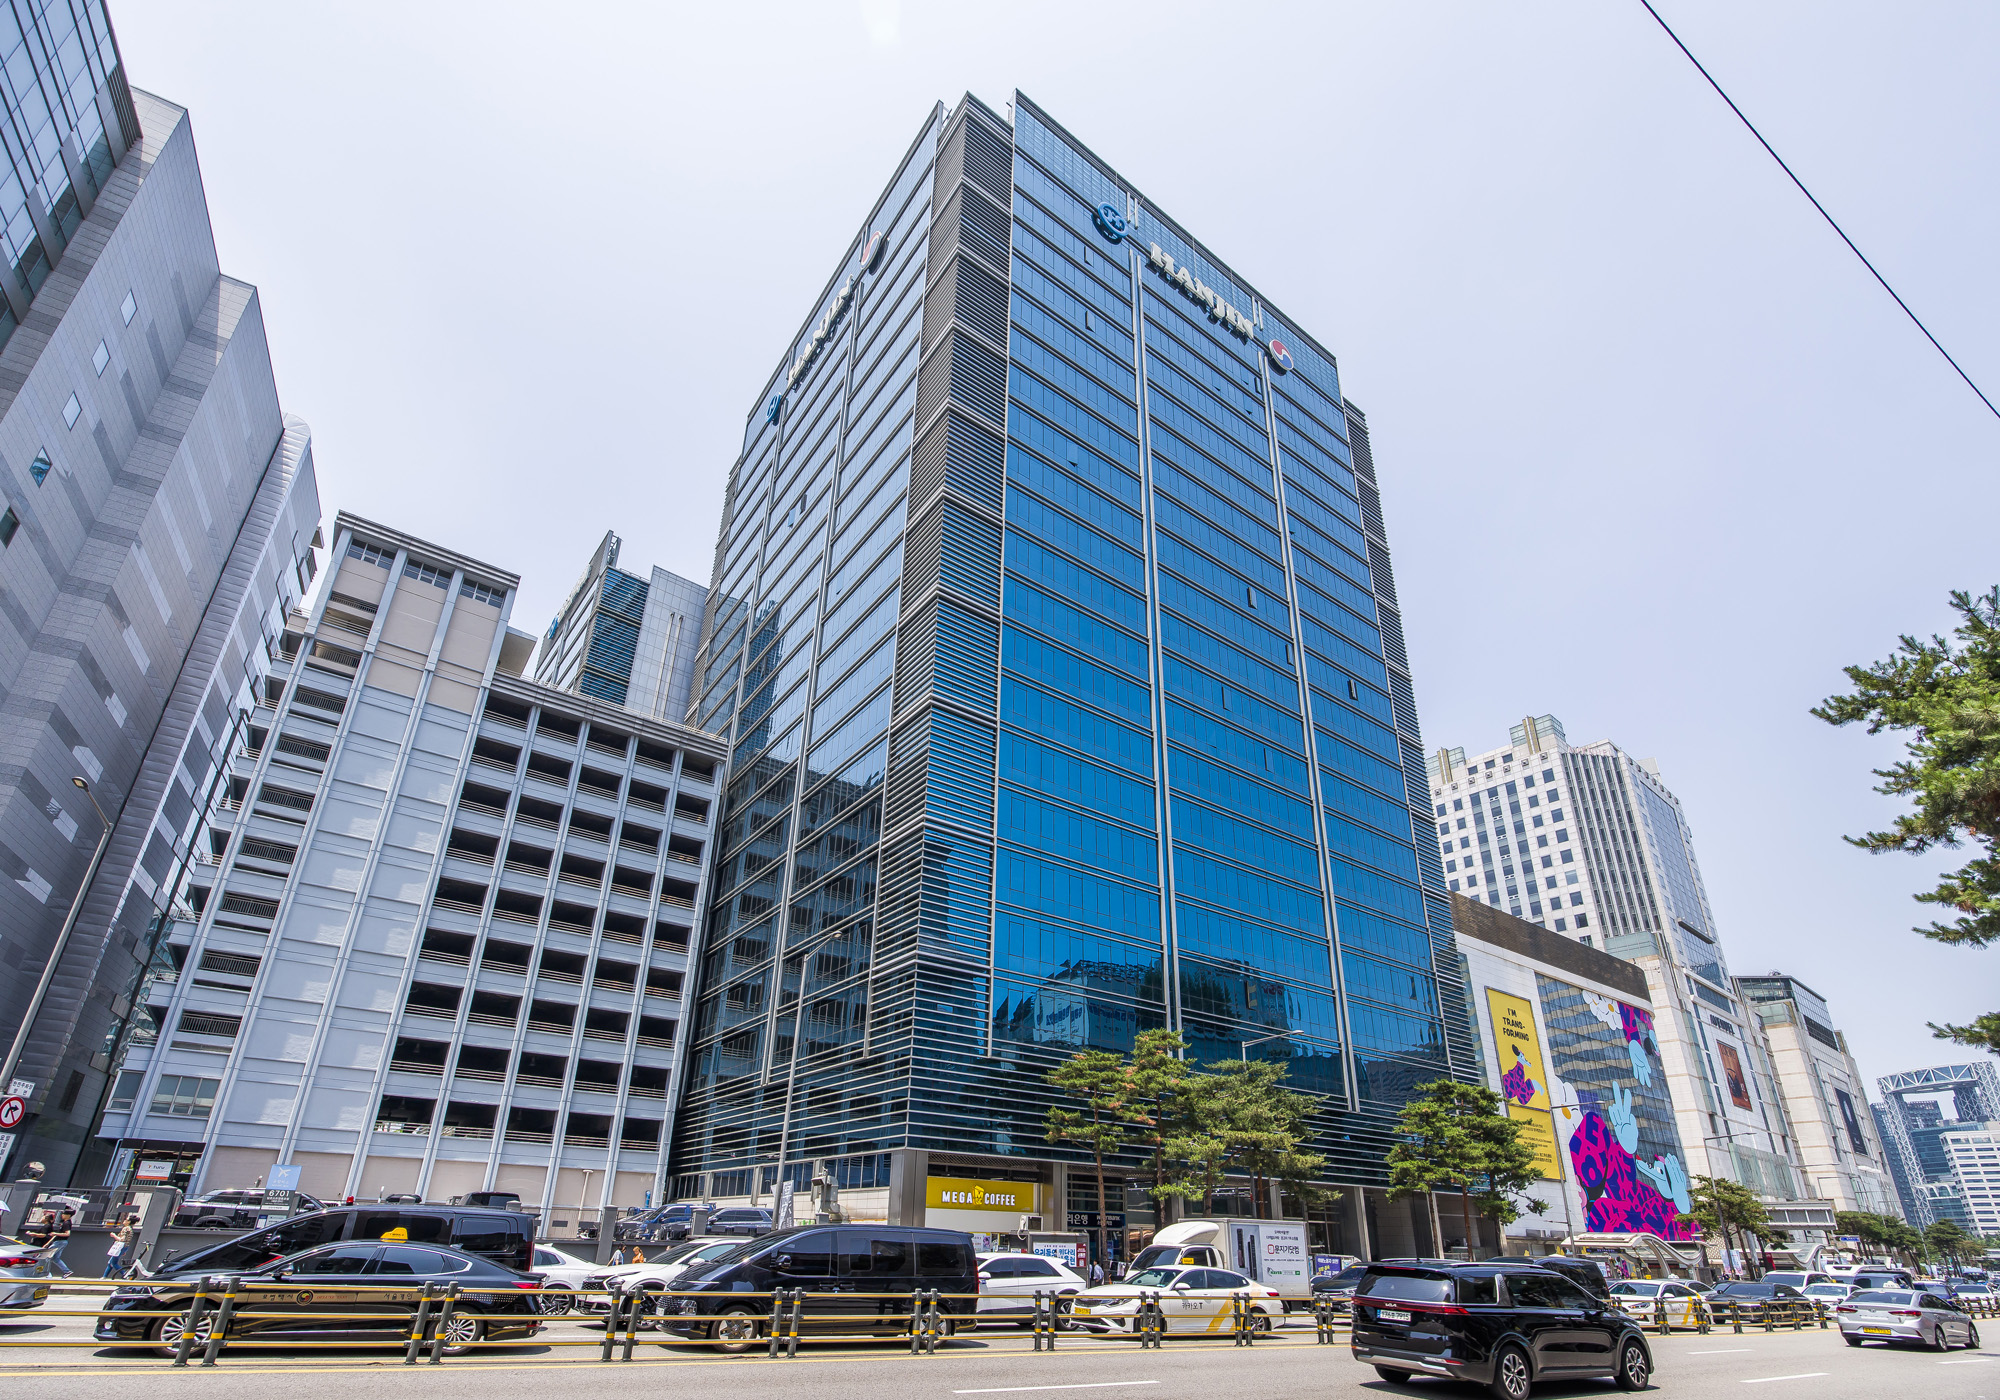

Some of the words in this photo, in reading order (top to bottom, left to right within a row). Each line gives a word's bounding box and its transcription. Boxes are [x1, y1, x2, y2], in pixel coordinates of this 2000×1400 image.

[1150, 241, 1255, 340] HANJIN
[1507, 1008, 1517, 1017] I'M
[1502, 1017, 1525, 1030] TRANS-
[1503, 1027, 1530, 1041] FORMING
[942, 1191, 973, 1204] MEGA
[984, 1193, 1016, 1206] COFFEE
[1067, 1214, 1088, 1225] 리은행
